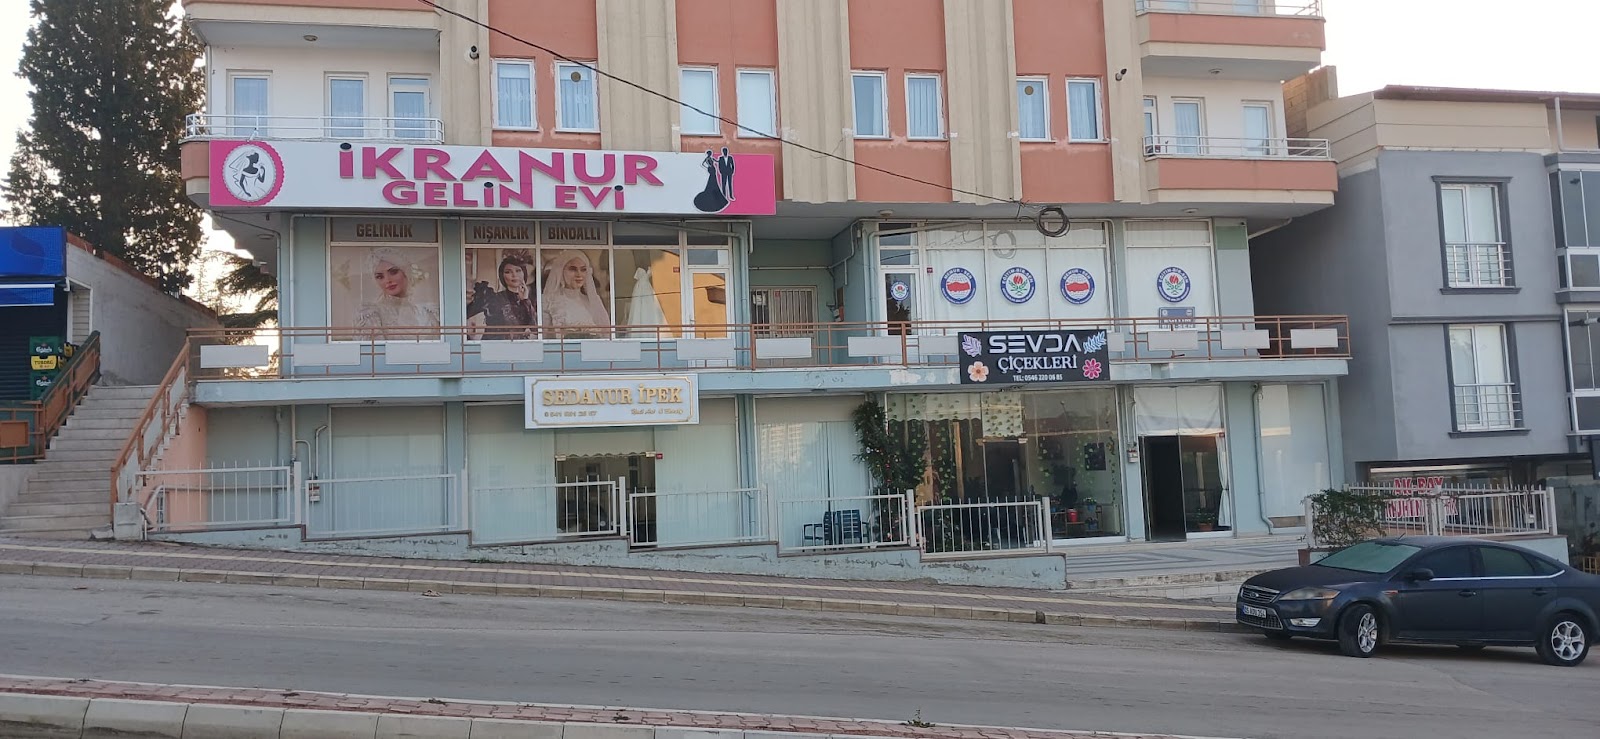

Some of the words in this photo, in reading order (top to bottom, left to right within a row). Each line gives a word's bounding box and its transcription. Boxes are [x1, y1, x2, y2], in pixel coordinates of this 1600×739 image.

[555, 184, 625, 210] EVİ
[473, 224, 530, 242] NİŞANLIK
[548, 224, 601, 241] BİNDALLI
[989, 333, 1082, 354] SEVDA
[997, 354, 1078, 374] ÇİÇEKLERİ
[542, 388, 632, 406] SEDANUR
[638, 383, 683, 404] İPEK
